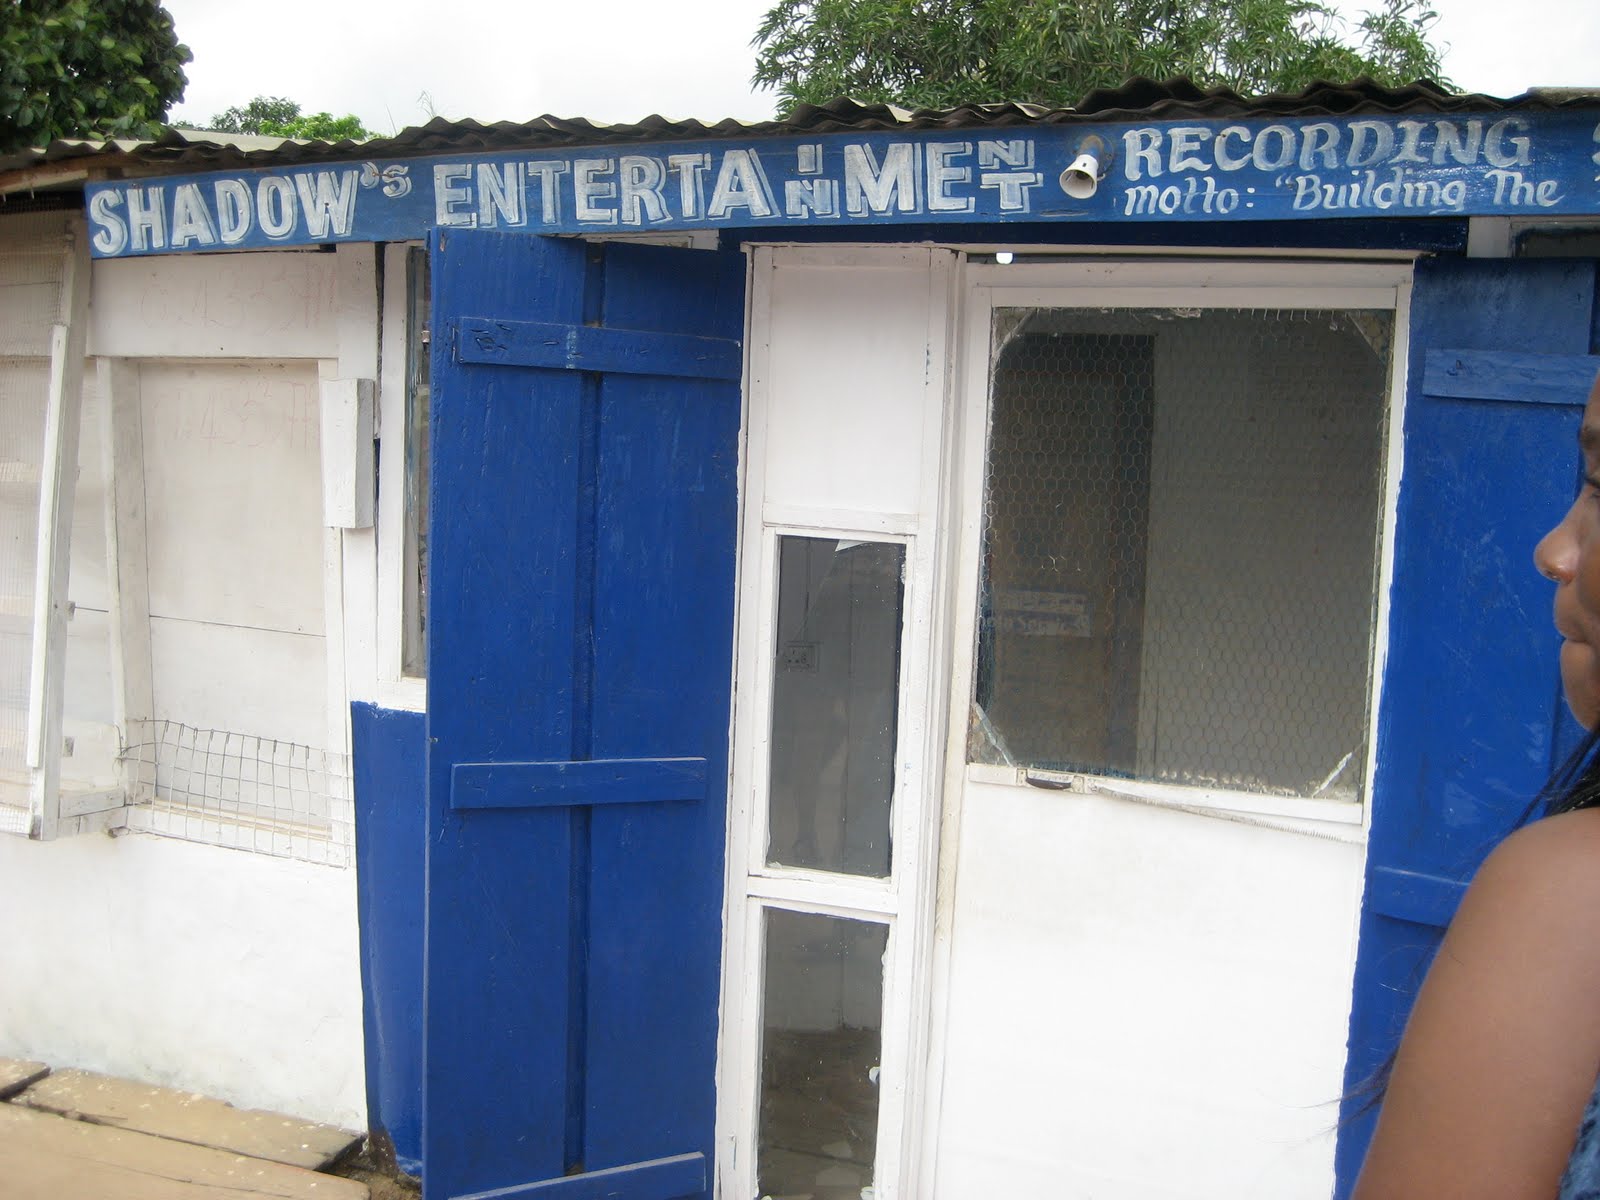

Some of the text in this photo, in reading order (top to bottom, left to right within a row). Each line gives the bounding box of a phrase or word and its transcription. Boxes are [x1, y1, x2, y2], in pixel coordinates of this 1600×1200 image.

[433, 139, 1044, 229] ENTERTAINMENT
[1122, 117, 1531, 181] RECORDING
[1484, 169, 1565, 207] The
